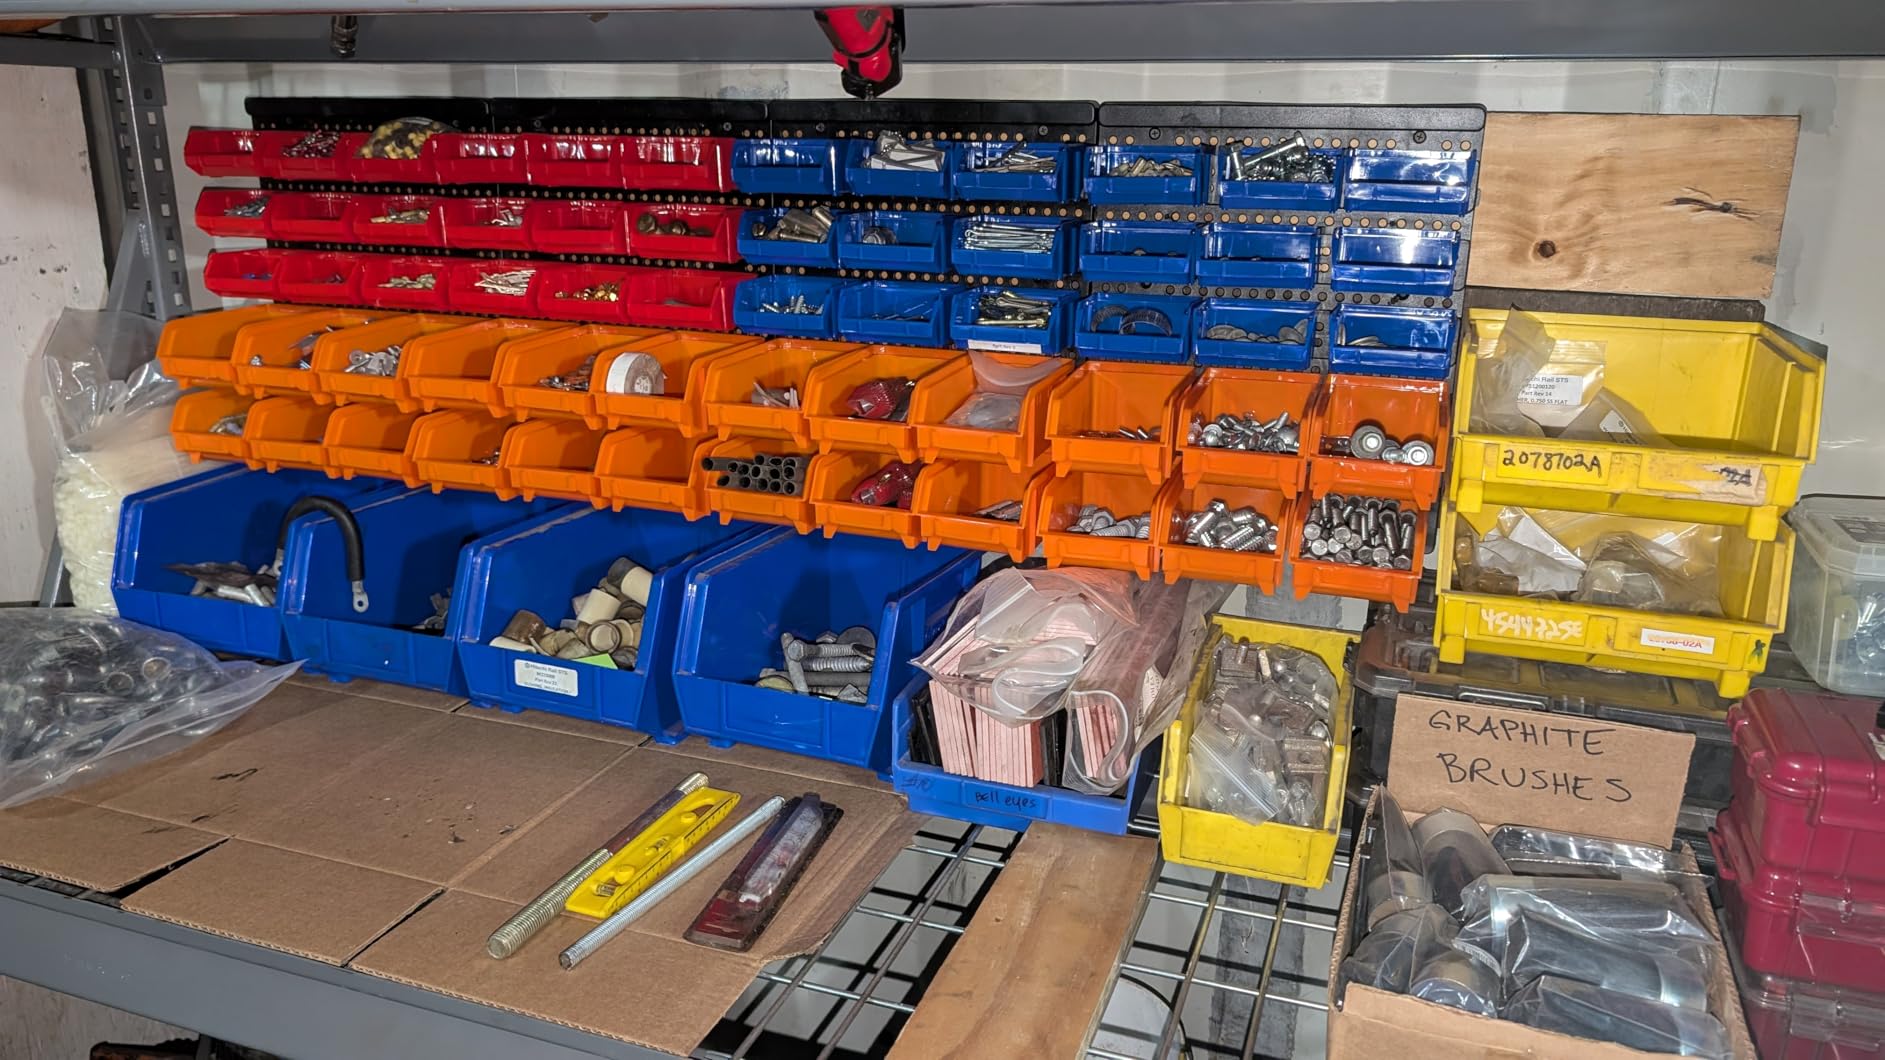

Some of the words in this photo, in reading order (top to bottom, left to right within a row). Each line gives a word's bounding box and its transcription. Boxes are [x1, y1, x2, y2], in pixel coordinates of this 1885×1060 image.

[1502, 449, 1602, 479] 2078702A
[1429, 709, 1616, 755] GRAPHITE
[1436, 752, 1632, 802] BRUSHES
[1004, 794, 1037, 811] eyes
